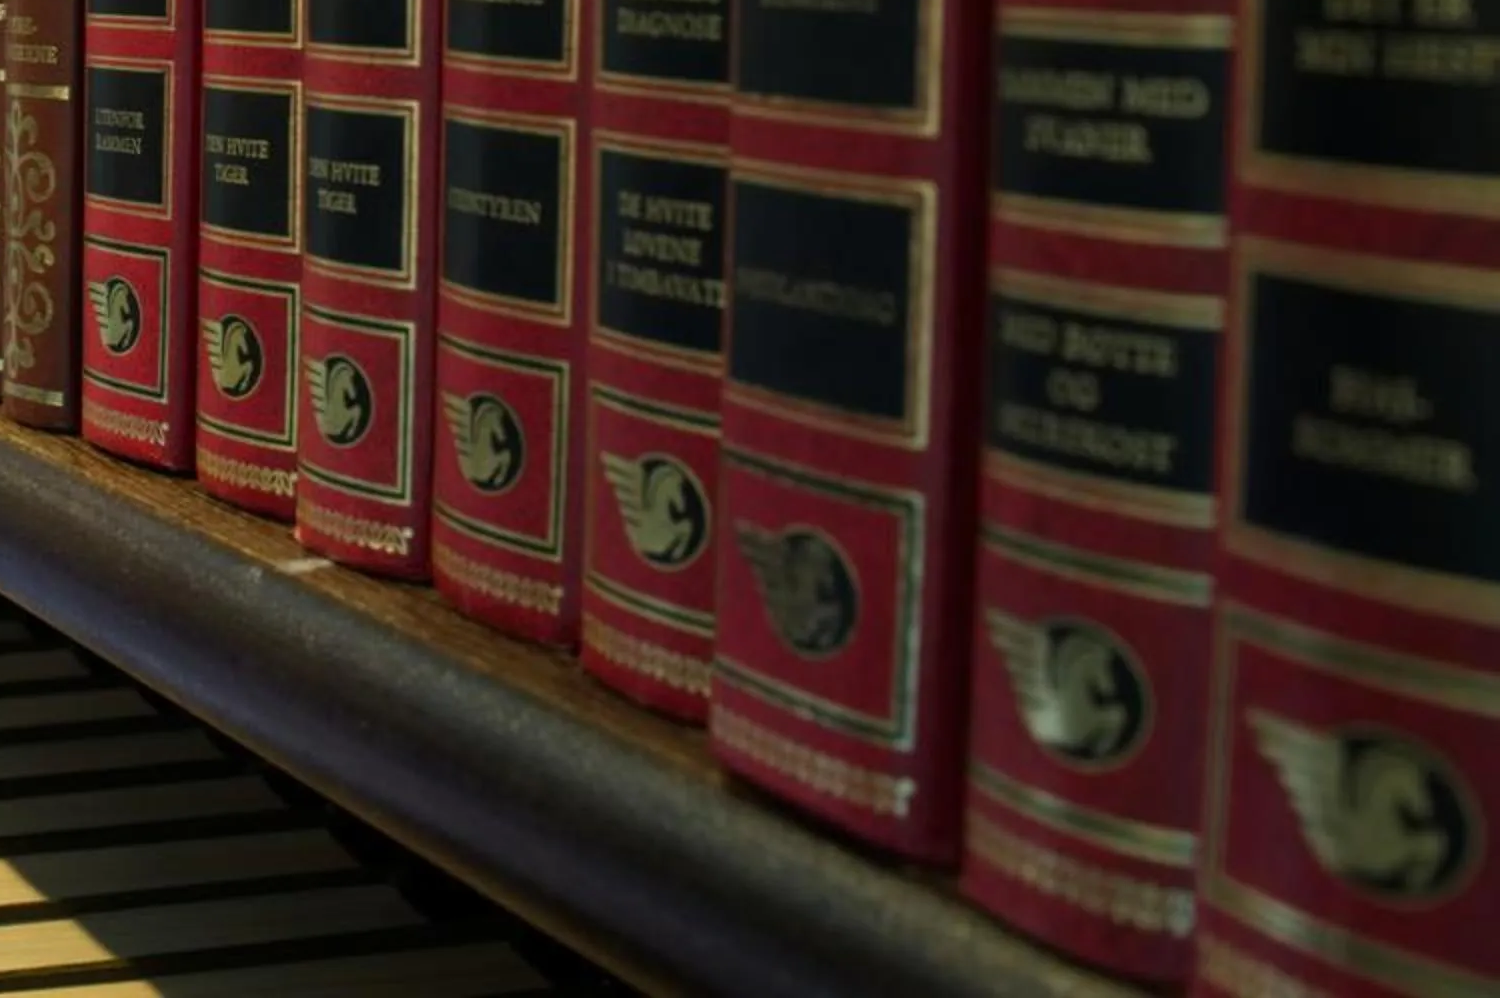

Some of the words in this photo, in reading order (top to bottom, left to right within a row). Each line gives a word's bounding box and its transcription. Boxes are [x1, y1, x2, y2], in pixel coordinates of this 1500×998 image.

[618, 8, 722, 41] DIAGNOSE
[226, 136, 270, 159] HVITE
[331, 161, 380, 187] HVITE
[645, 195, 713, 233] HVITE
